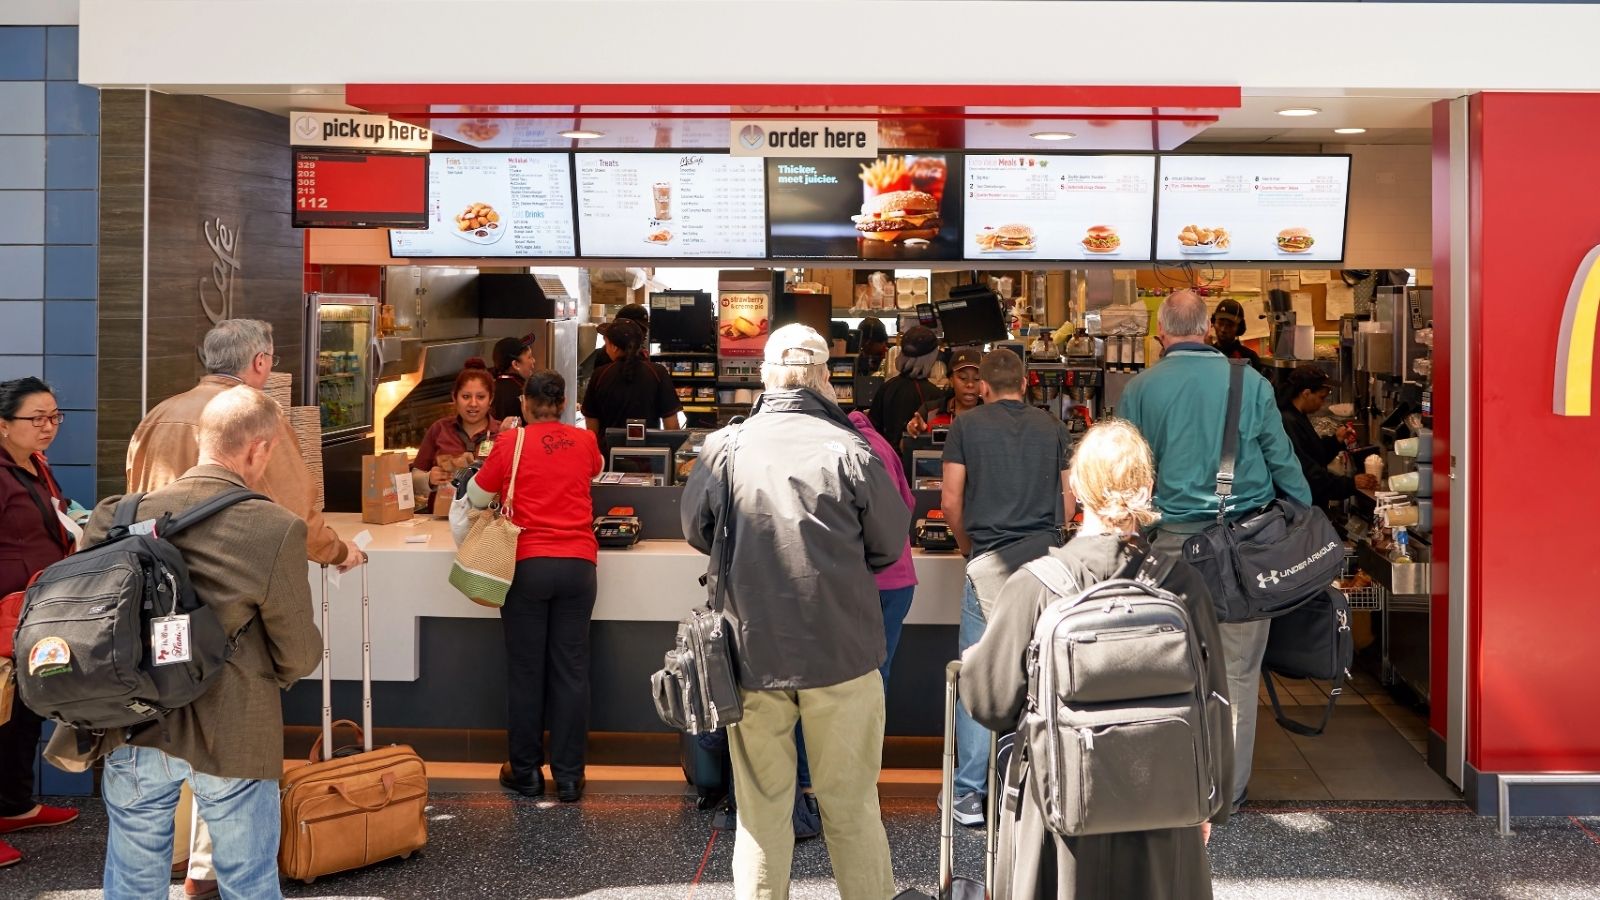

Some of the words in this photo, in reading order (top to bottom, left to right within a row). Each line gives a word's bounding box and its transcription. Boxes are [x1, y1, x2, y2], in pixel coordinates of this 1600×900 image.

[323, 118, 360, 141] pick
[364, 123, 384, 142] up
[388, 121, 428, 141] here
[769, 127, 818, 148] order
[824, 127, 866, 148] here
[778, 165, 817, 174] Thicker,
[778, 175, 803, 183] meet
[804, 175, 838, 185] juicier.
[298, 197, 328, 208] 112
[525, 210, 544, 218] Drinks
[199, 217, 240, 328] Café
[730, 296, 763, 304] strawberry
[1280, 561, 1307, 577] UNDER
[1307, 541, 1337, 565] ARMOUR
